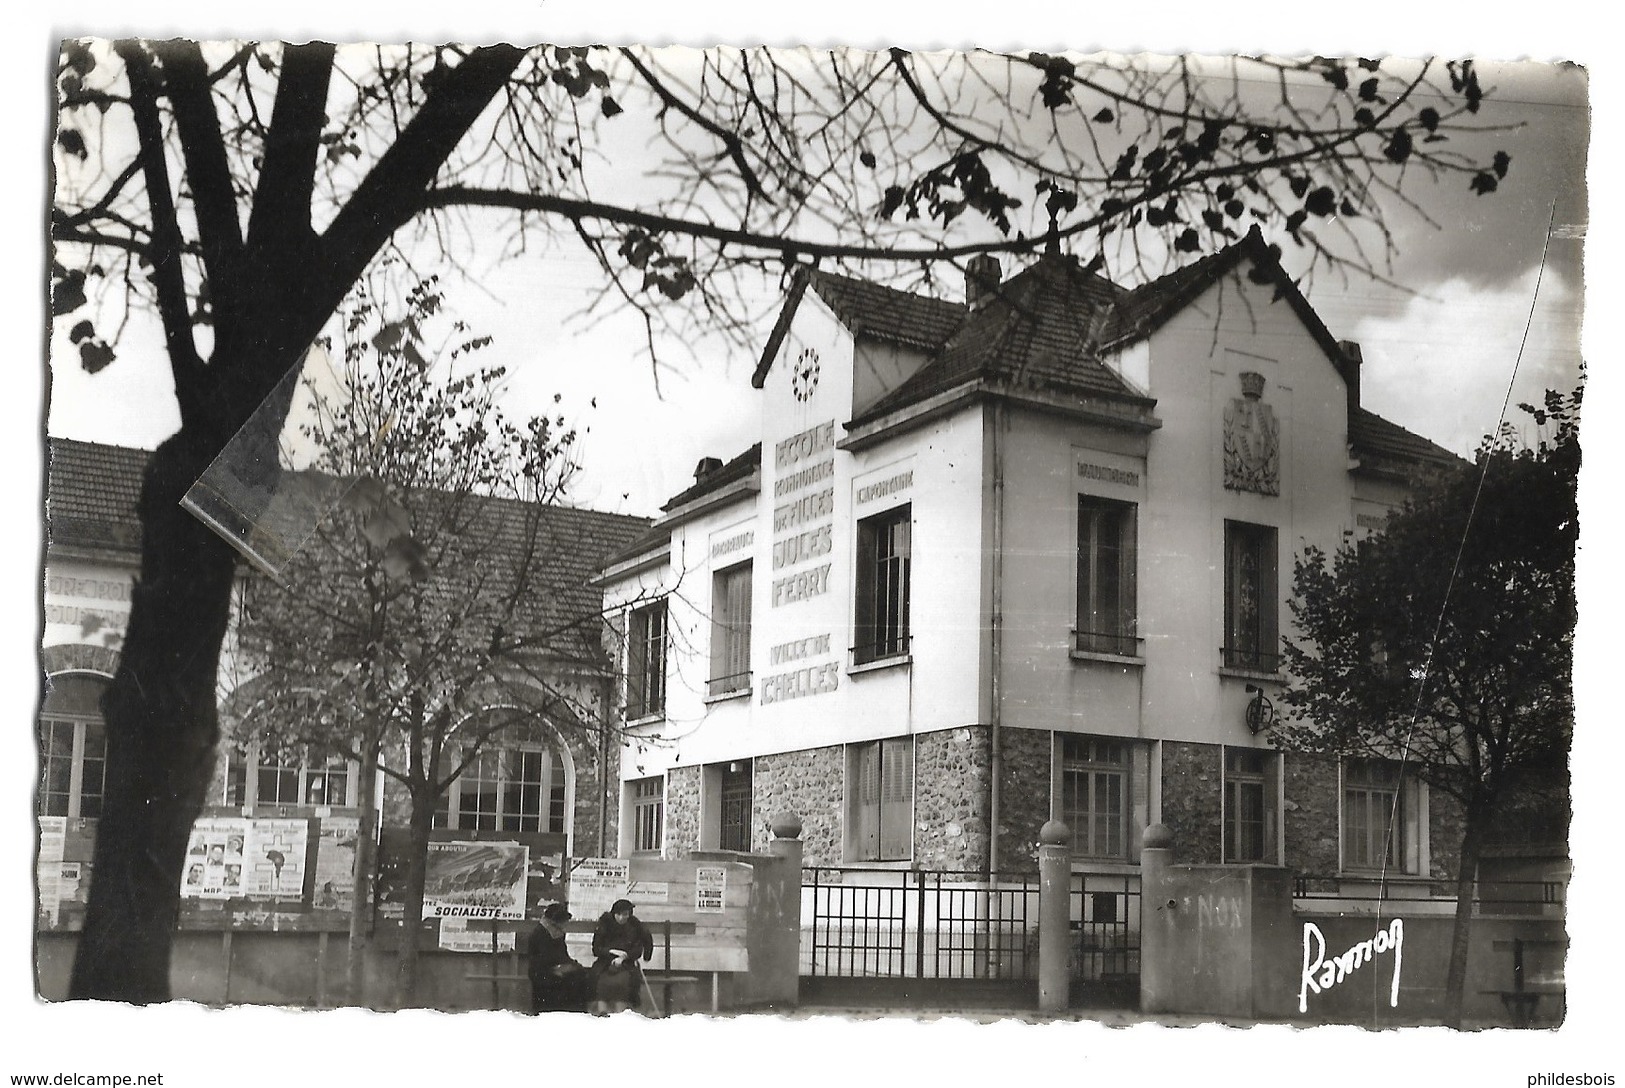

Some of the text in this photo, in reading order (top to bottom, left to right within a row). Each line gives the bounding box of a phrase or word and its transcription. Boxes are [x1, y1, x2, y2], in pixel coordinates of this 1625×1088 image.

[775, 419, 834, 471] ECOLE
[789, 487, 834, 527] FILLES
[773, 524, 833, 571] JULES
[772, 563, 832, 608] FERRY
[771, 633, 831, 666] VILLE DE
[761, 662, 839, 706] CHELLES
[435, 906, 502, 918] SOCIALISTE
